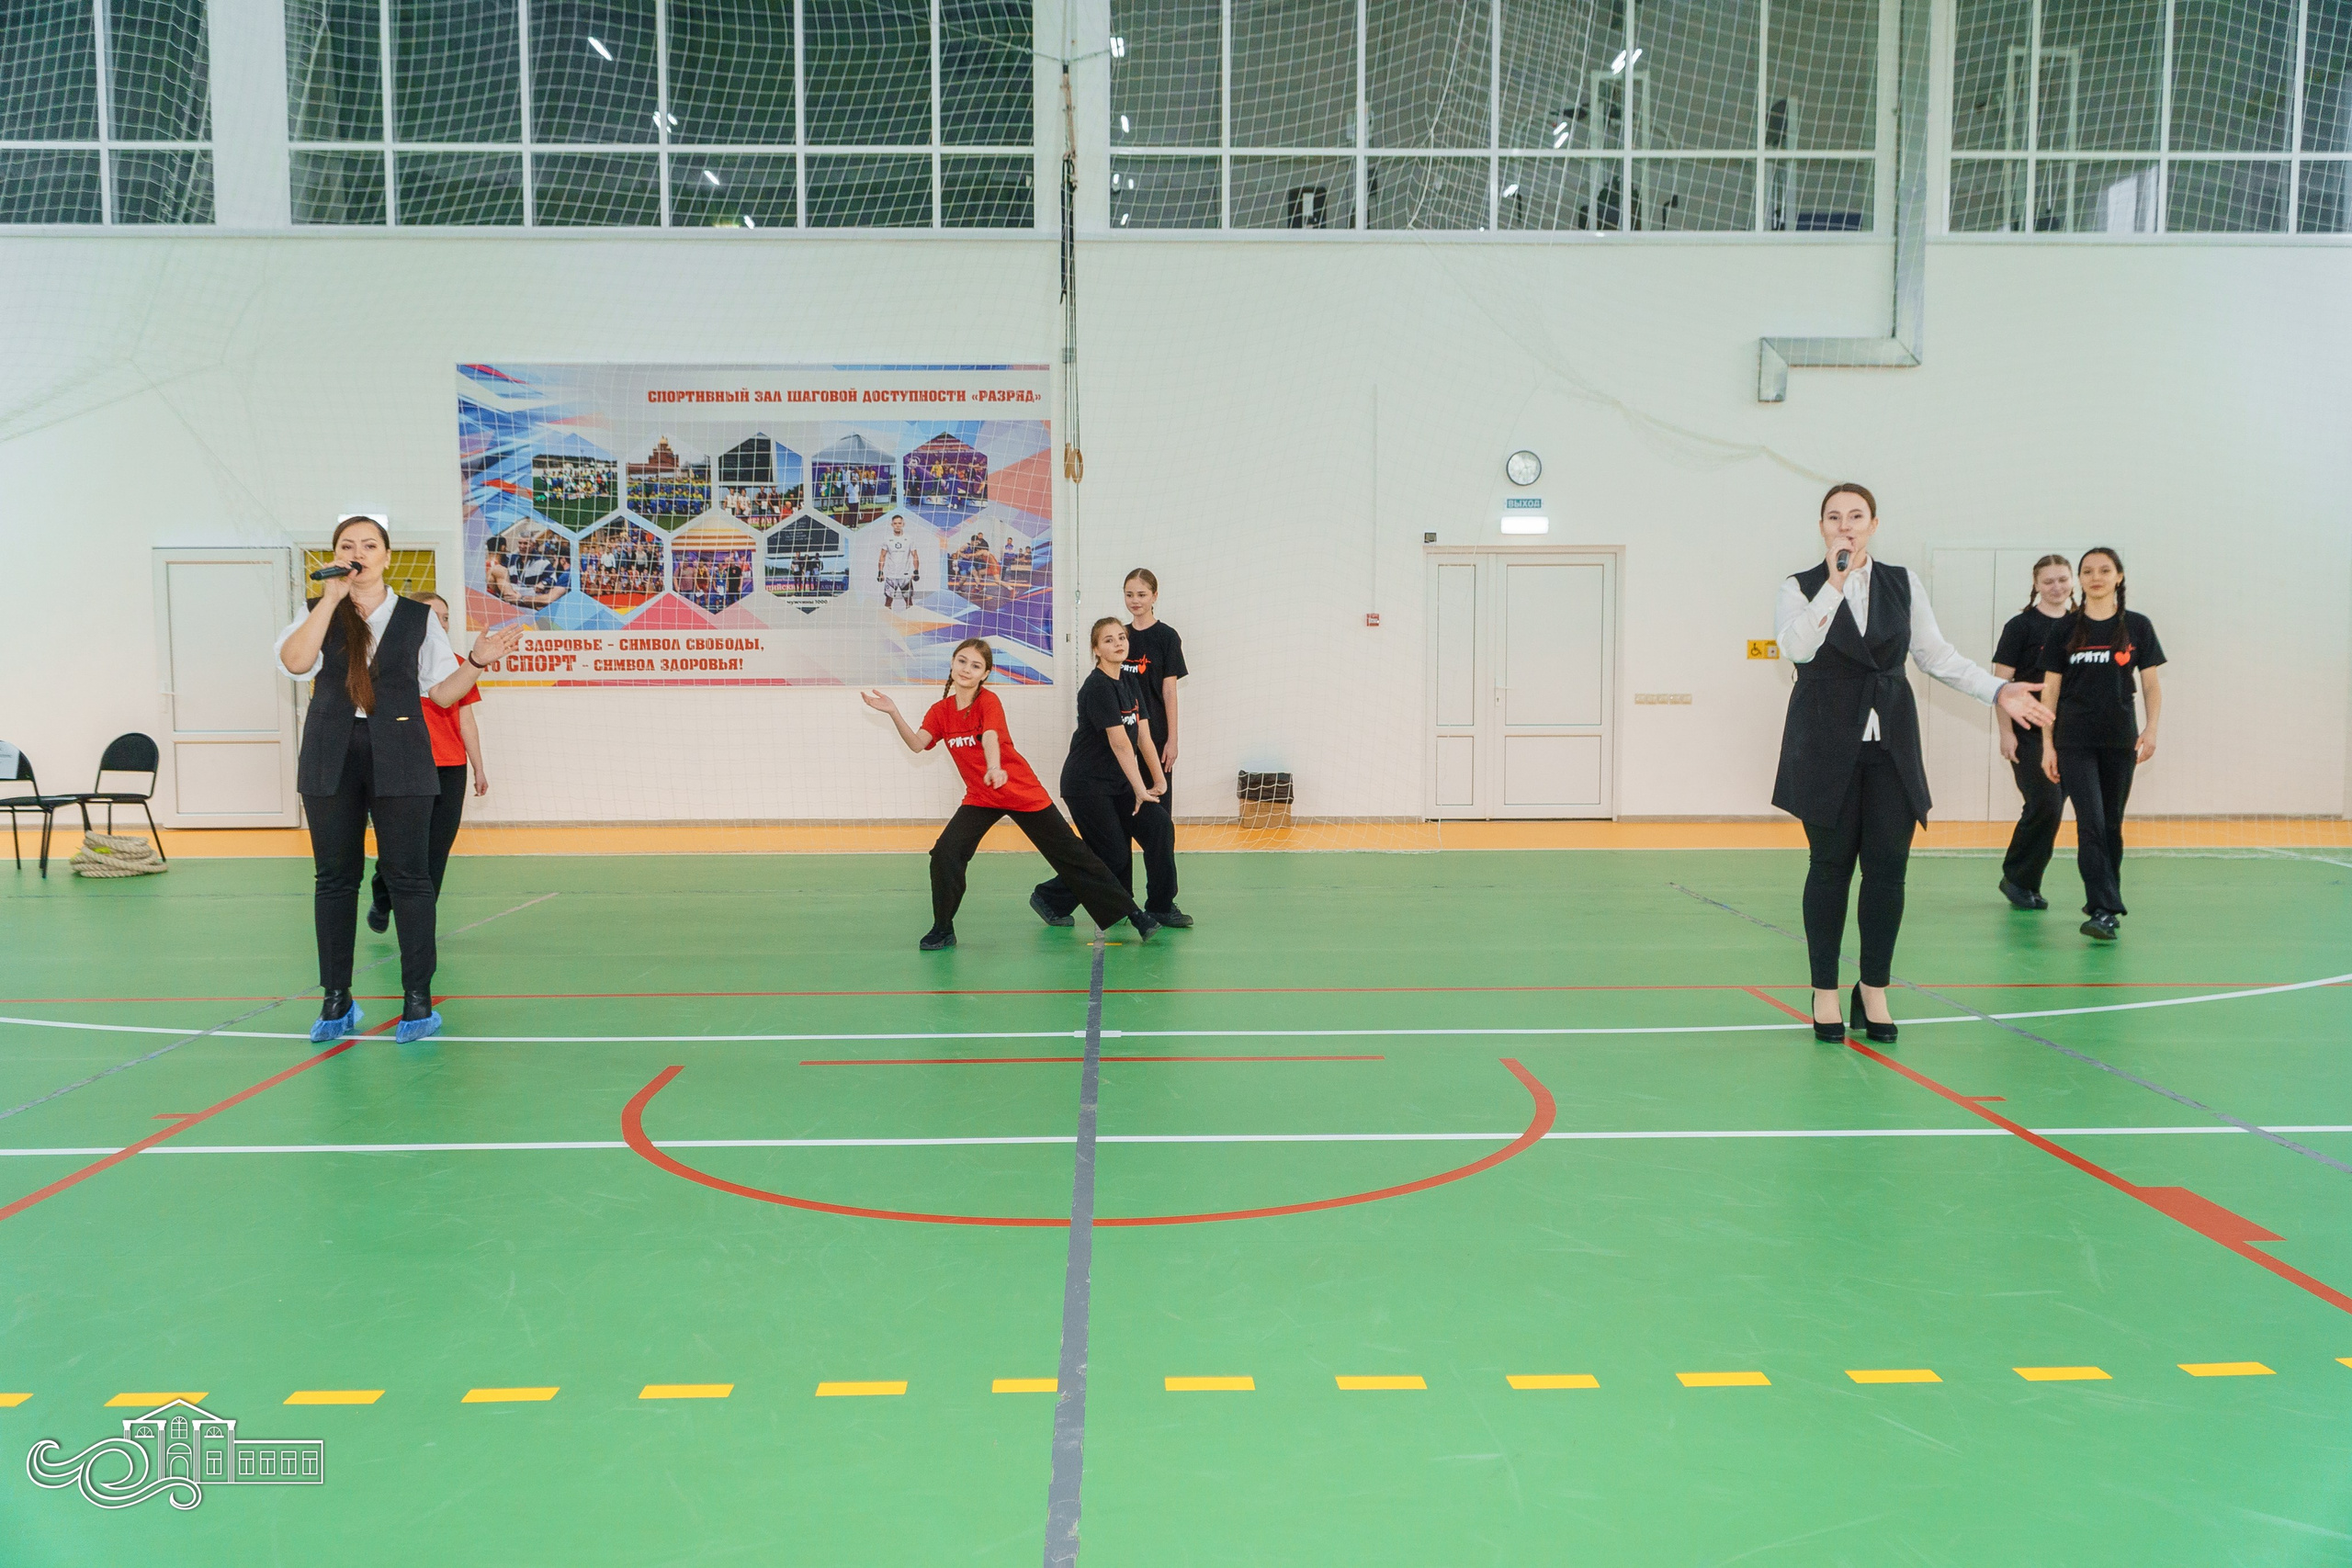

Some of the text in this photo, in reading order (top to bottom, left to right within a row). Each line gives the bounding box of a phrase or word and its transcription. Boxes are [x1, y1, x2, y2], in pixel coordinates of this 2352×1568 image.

[648, 388, 1042, 403] СПОРТИВНЫЙ ЗАЛ ШАГОВОЙ ДОСТУПНОСТИ «РАЗРЯД»
[1508, 499, 1541, 508] ВЫХОД
[525, 638, 603, 652] ЗДОРОВЬЕ
[619, 638, 681, 650] СИМВОЛ
[685, 637, 764, 652] СВОБОДЫ,
[506, 654, 577, 672] СПОРТ
[594, 659, 655, 671] СИМВОЛ
[661, 658, 743, 671] ЗДОРОВЬЯ!
